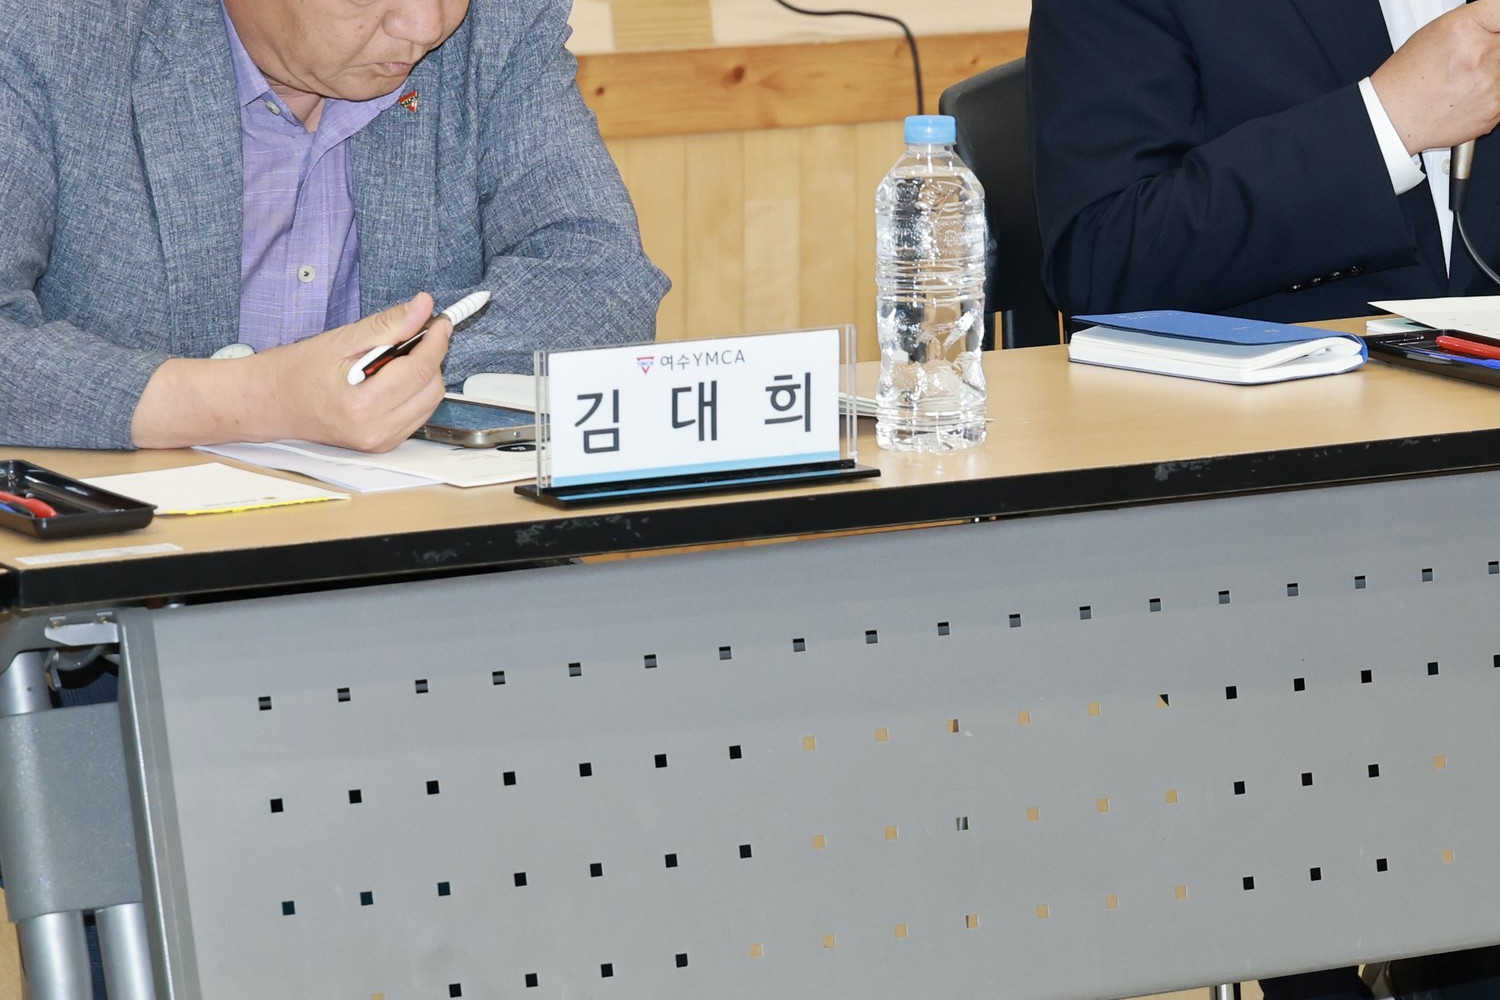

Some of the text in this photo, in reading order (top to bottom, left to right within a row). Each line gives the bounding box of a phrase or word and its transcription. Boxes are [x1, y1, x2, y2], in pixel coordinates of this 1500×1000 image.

[660, 349, 746, 371] 여수YMCA
[574, 372, 811, 454] 김 대 희
